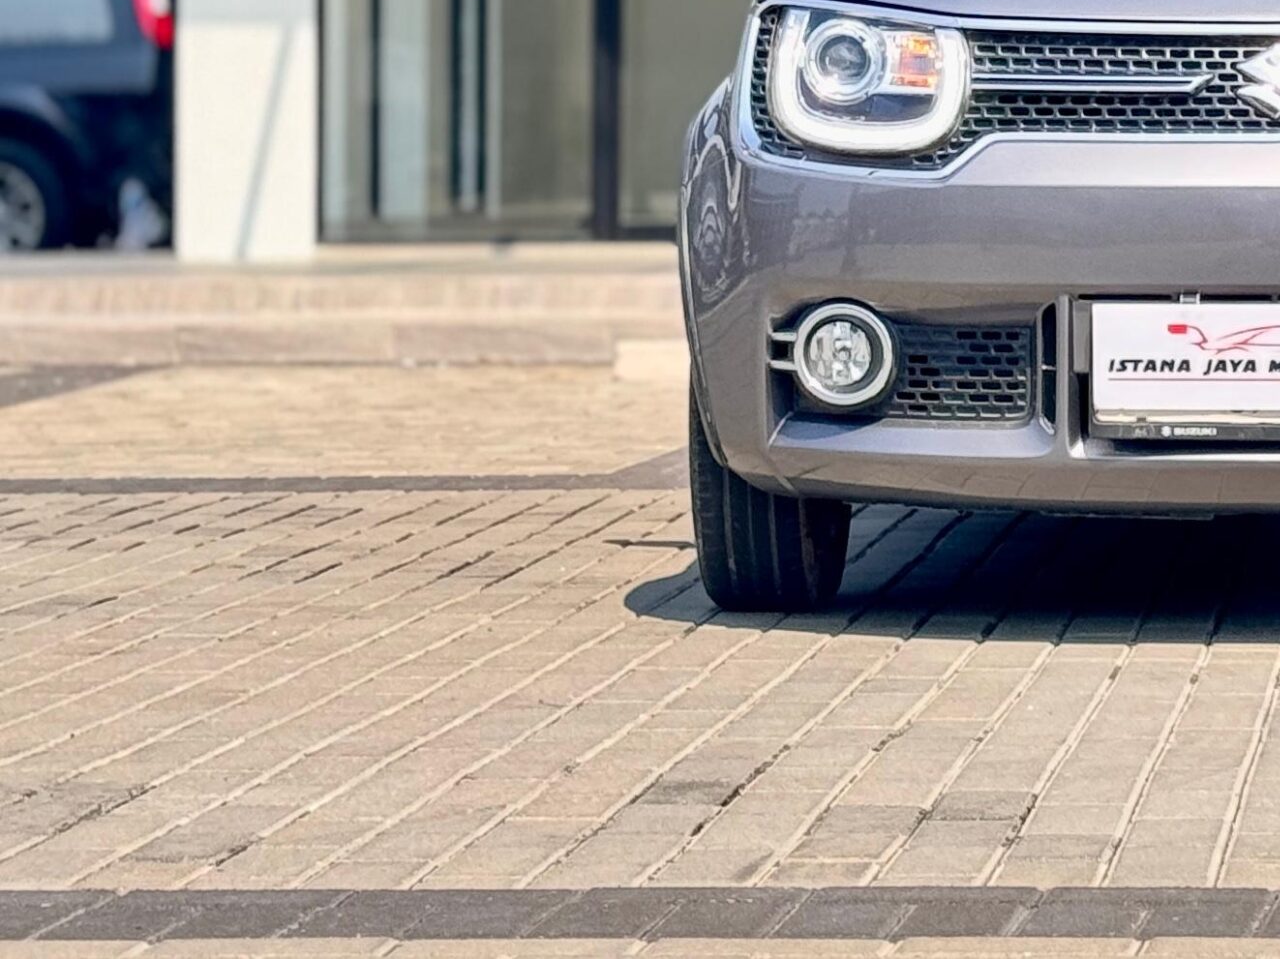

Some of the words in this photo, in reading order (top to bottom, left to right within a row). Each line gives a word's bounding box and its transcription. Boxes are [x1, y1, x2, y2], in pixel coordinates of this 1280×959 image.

[1108, 359, 1191, 373] ISTANA
[1203, 359, 1257, 376] JAYA
[1173, 427, 1217, 436] SUZUKI
